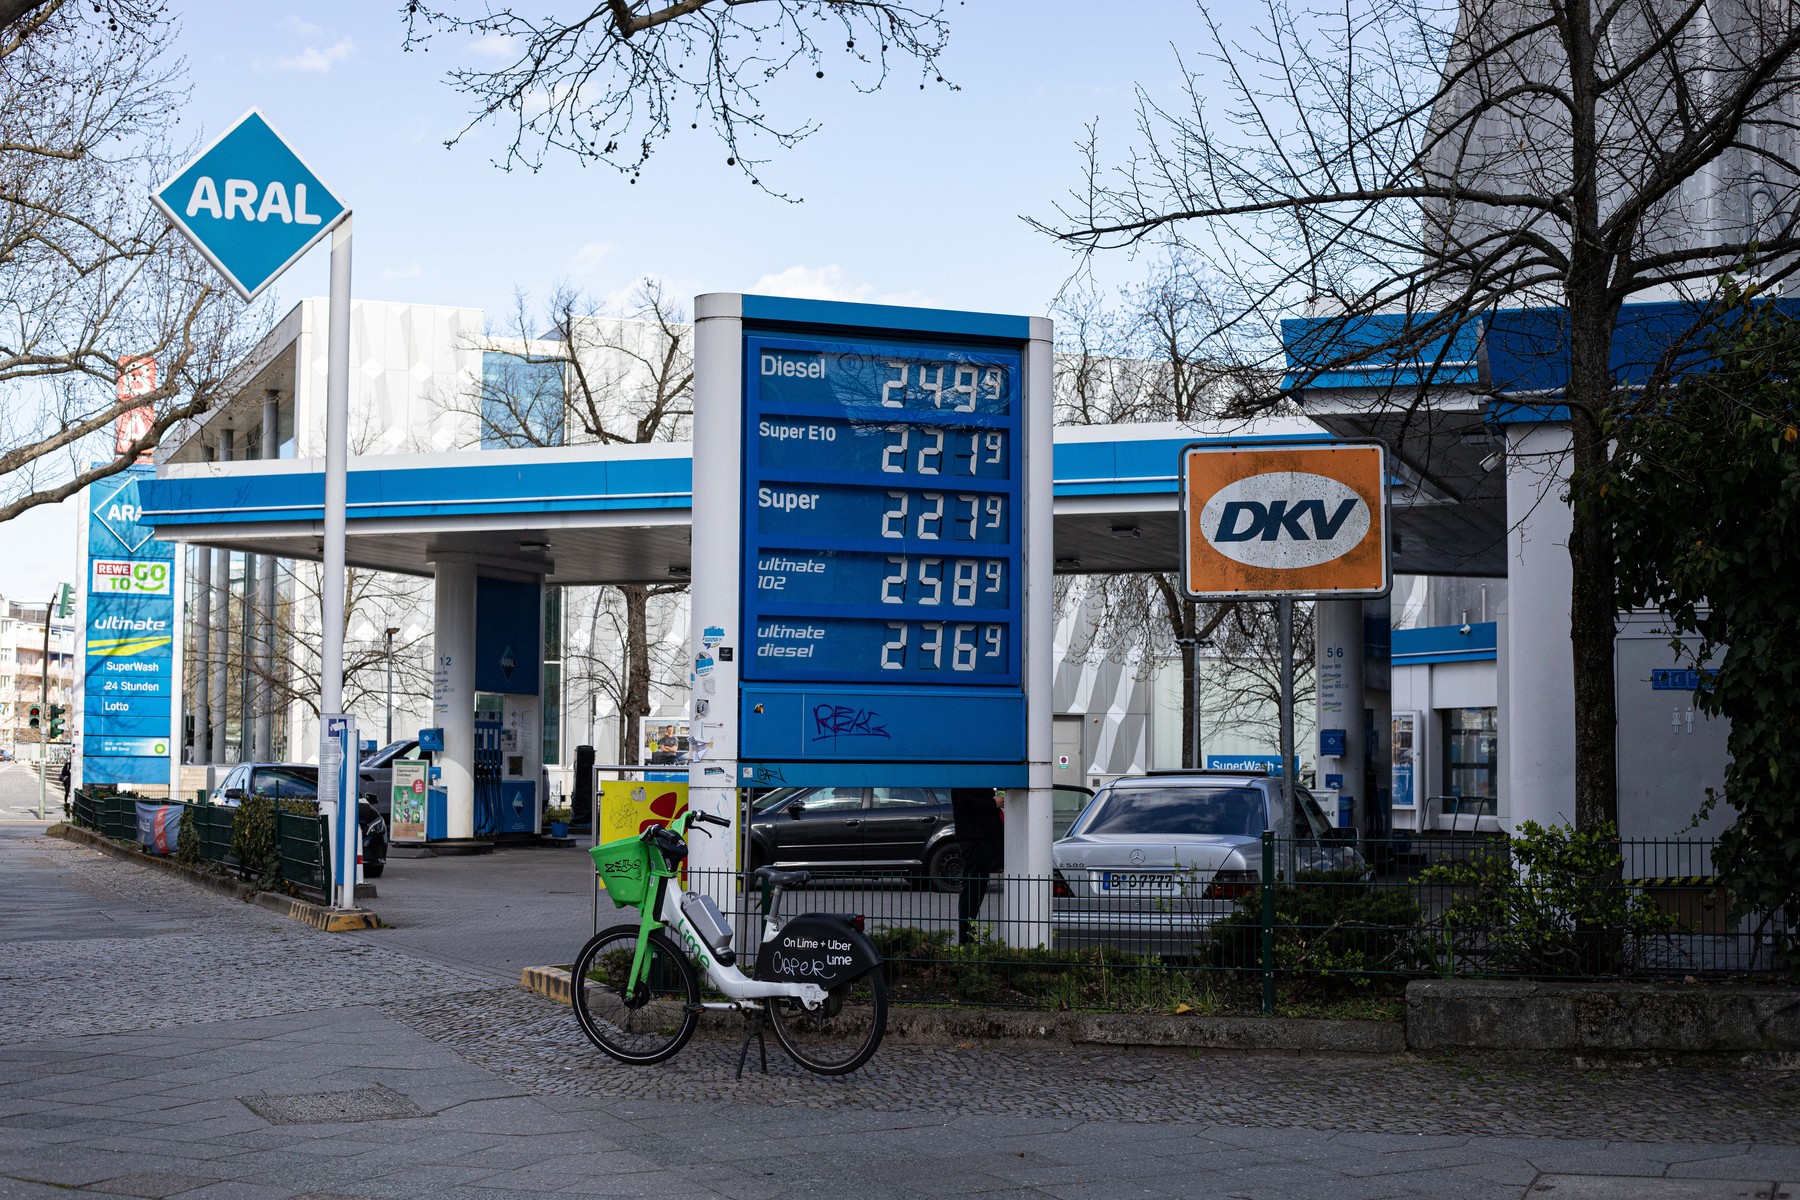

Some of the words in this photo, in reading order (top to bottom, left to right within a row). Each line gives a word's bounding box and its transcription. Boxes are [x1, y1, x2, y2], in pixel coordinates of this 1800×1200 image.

[186, 176, 322, 225] ARAL
[760, 355, 826, 379] Diesel
[759, 421, 806, 441] Super
[808, 425, 836, 442] E10
[758, 487, 820, 512] Super
[1214, 498, 1360, 542] DKV
[98, 564, 130, 576] REWE
[133, 564, 166, 582] GO
[758, 557, 826, 574] ultimate
[109, 577, 131, 591] TO
[758, 575, 787, 590] 102
[94, 616, 166, 631] ultimate
[757, 624, 825, 640] ultimate
[757, 643, 814, 658] diesel
[106, 661, 159, 673] SuperWash
[105, 681, 118, 691] 24
[120, 681, 159, 692] Stunden
[104, 701, 129, 712] Lotto
[677, 918, 710, 970] Lime
[783, 937, 796, 948] On
[797, 938, 818, 949] Lime
[827, 940, 852, 951] Uber
[826, 955, 852, 965] Lime
